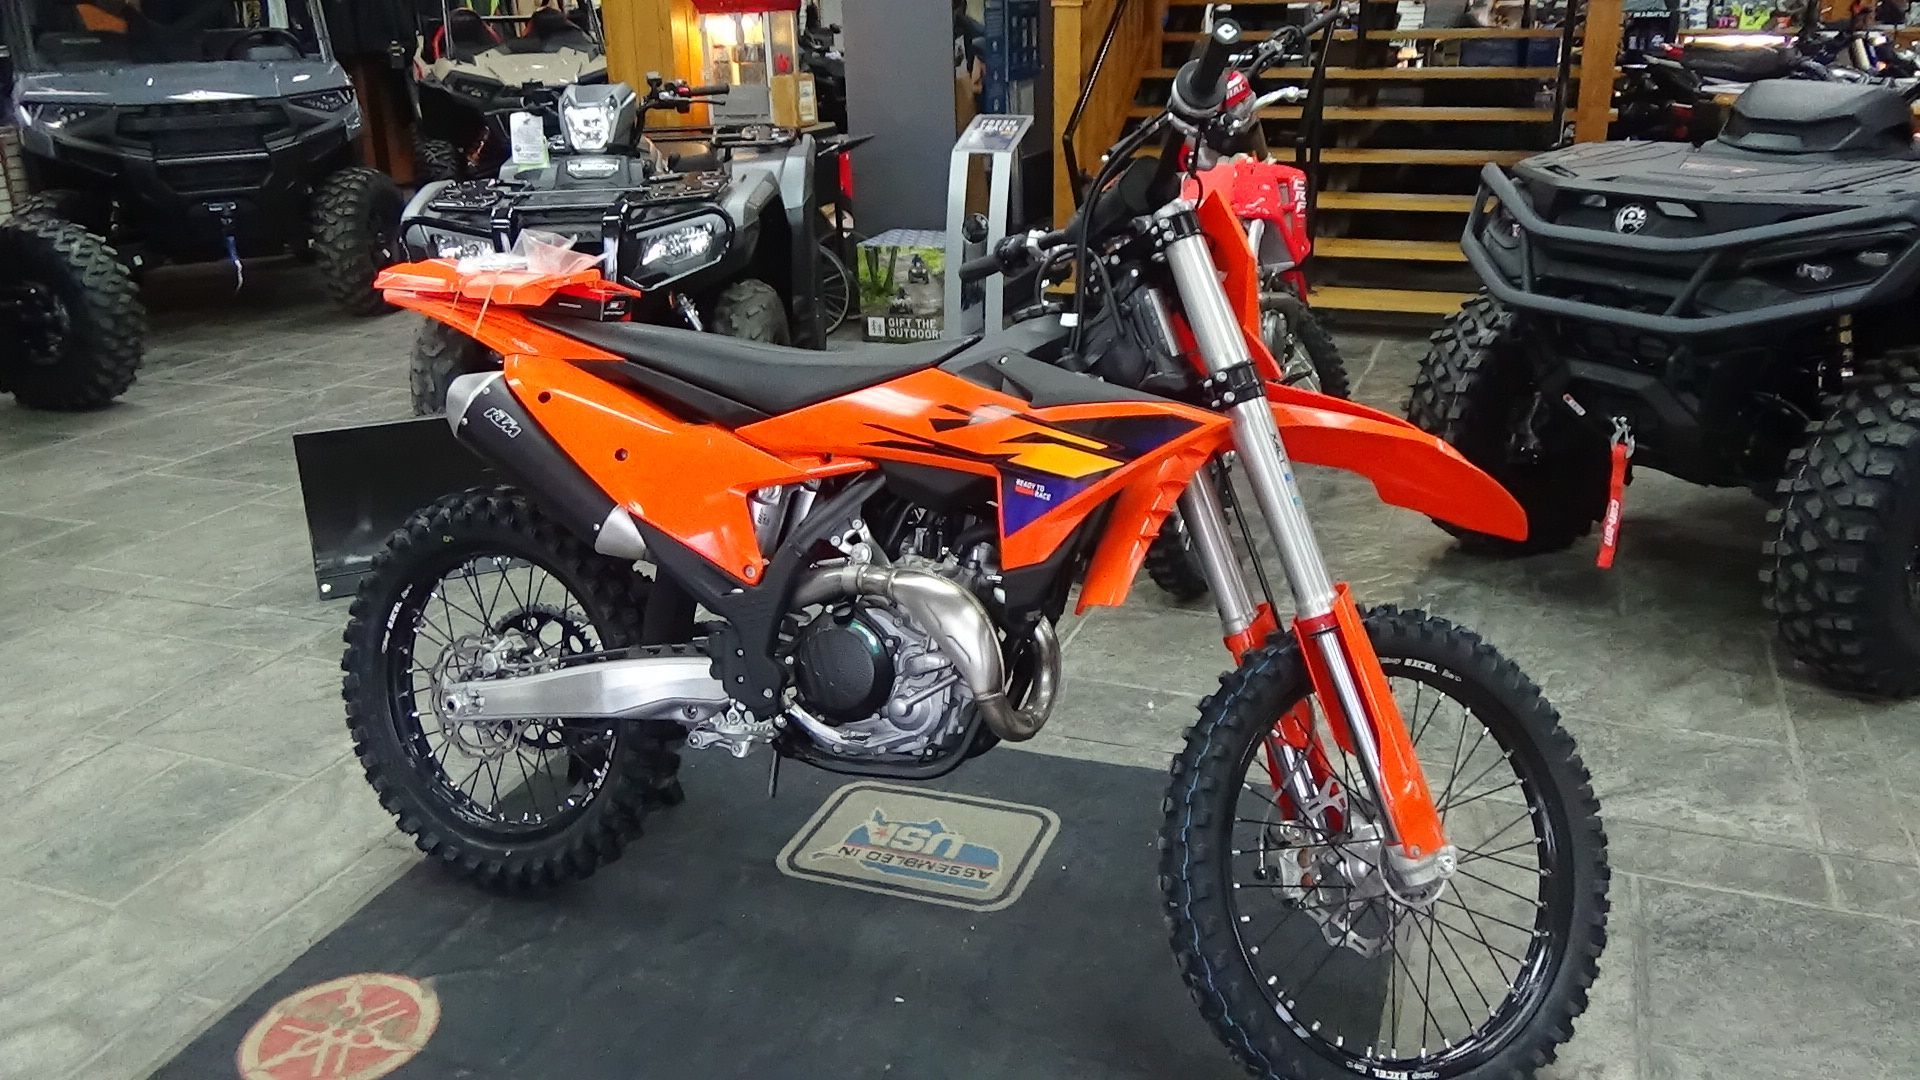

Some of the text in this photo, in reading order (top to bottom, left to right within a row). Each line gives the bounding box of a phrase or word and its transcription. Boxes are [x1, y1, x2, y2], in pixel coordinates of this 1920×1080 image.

[888, 317, 937, 329] GIFT THE
[483, 407, 522, 438] KTM
[1016, 478, 1045, 492] READY TO
[1034, 490, 1052, 501] RACE
[1403, 658, 1438, 673] EXCEL
[868, 822, 966, 861] USA
[838, 846, 993, 880] ASSEMBLED IN
